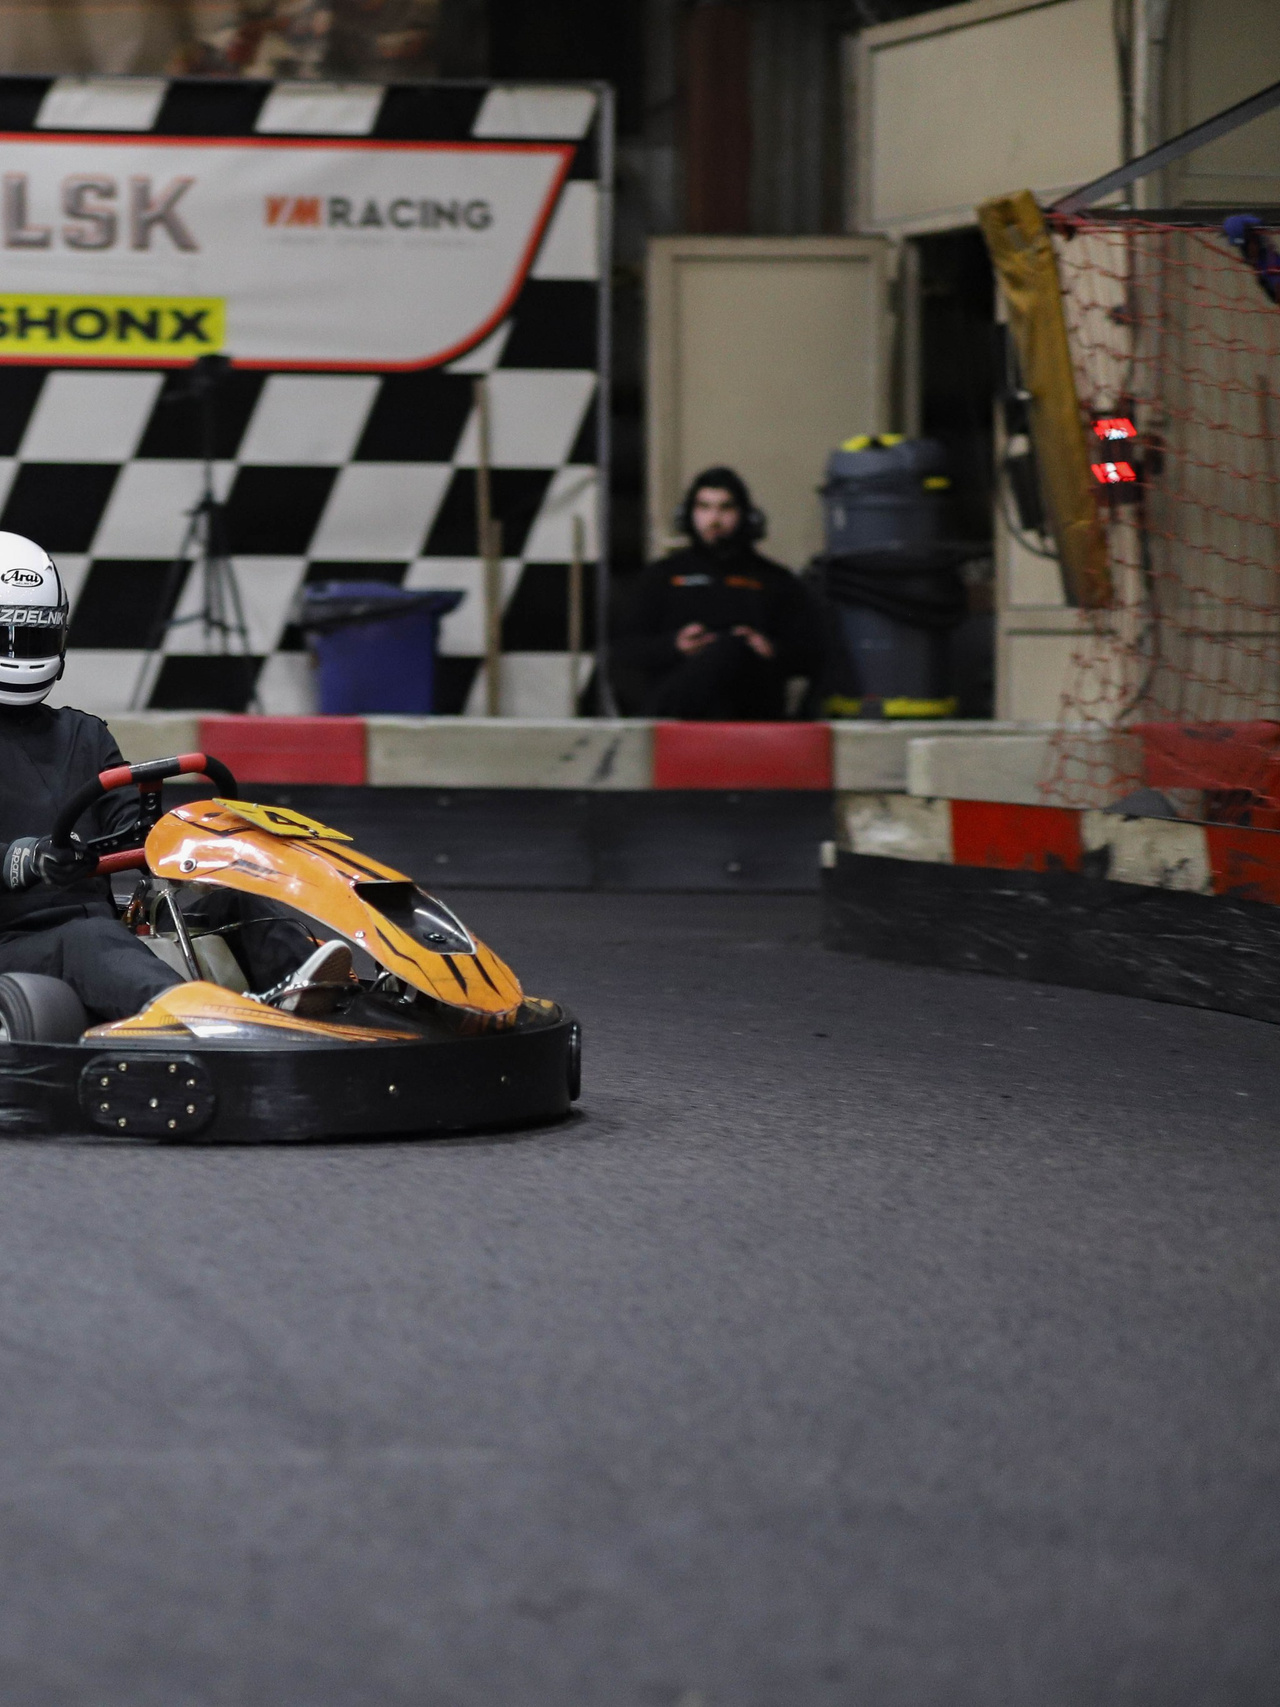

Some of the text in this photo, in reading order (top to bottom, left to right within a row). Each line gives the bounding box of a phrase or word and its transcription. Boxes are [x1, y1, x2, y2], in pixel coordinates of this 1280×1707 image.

[1, 171, 200, 253] LSK
[5, 570, 39, 583] Arai
[10, 846, 22, 887] sparc
